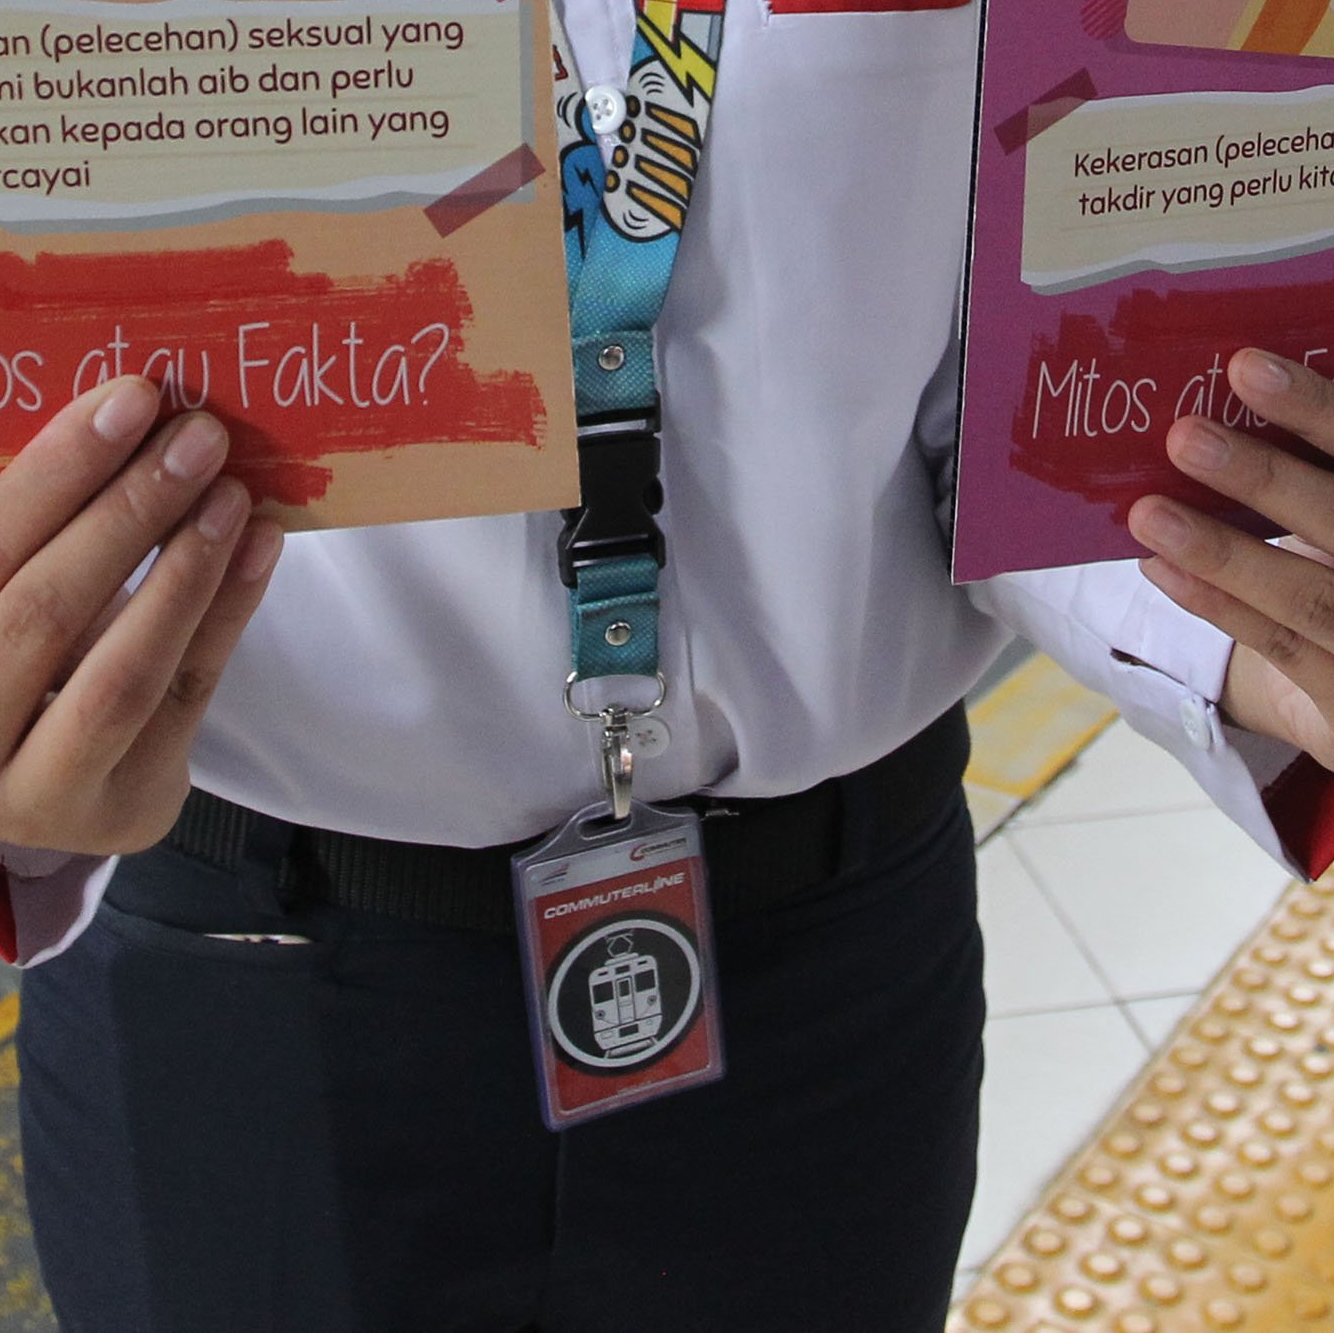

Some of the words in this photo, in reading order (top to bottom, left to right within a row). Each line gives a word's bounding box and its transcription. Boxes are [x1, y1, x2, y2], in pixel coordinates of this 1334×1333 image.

[40, 18, 239, 64] (pelecehan)
[248, 15, 372, 50] seksual
[381, 18, 464, 53] yang
[33, 66, 189, 100] bukanlah
[198, 65, 250, 95] aib
[258, 63, 320, 93] dan
[330, 59, 414, 100] perlu
[60, 111, 185, 151] kepada
[194, 115, 293, 145] orang
[301, 106, 359, 136] lain
[367, 108, 450, 141] yang
[1074, 145, 1208, 178] Kekerasan
[1078, 184, 1156, 216] takdir
[1161, 182, 1224, 214] yang
[1230, 168, 1293, 207] perlu
[238, 321, 450, 409] Fakta?
[1032, 357, 1157, 439] Mitos
[543, 872, 685, 919] COMMUTERLINE
